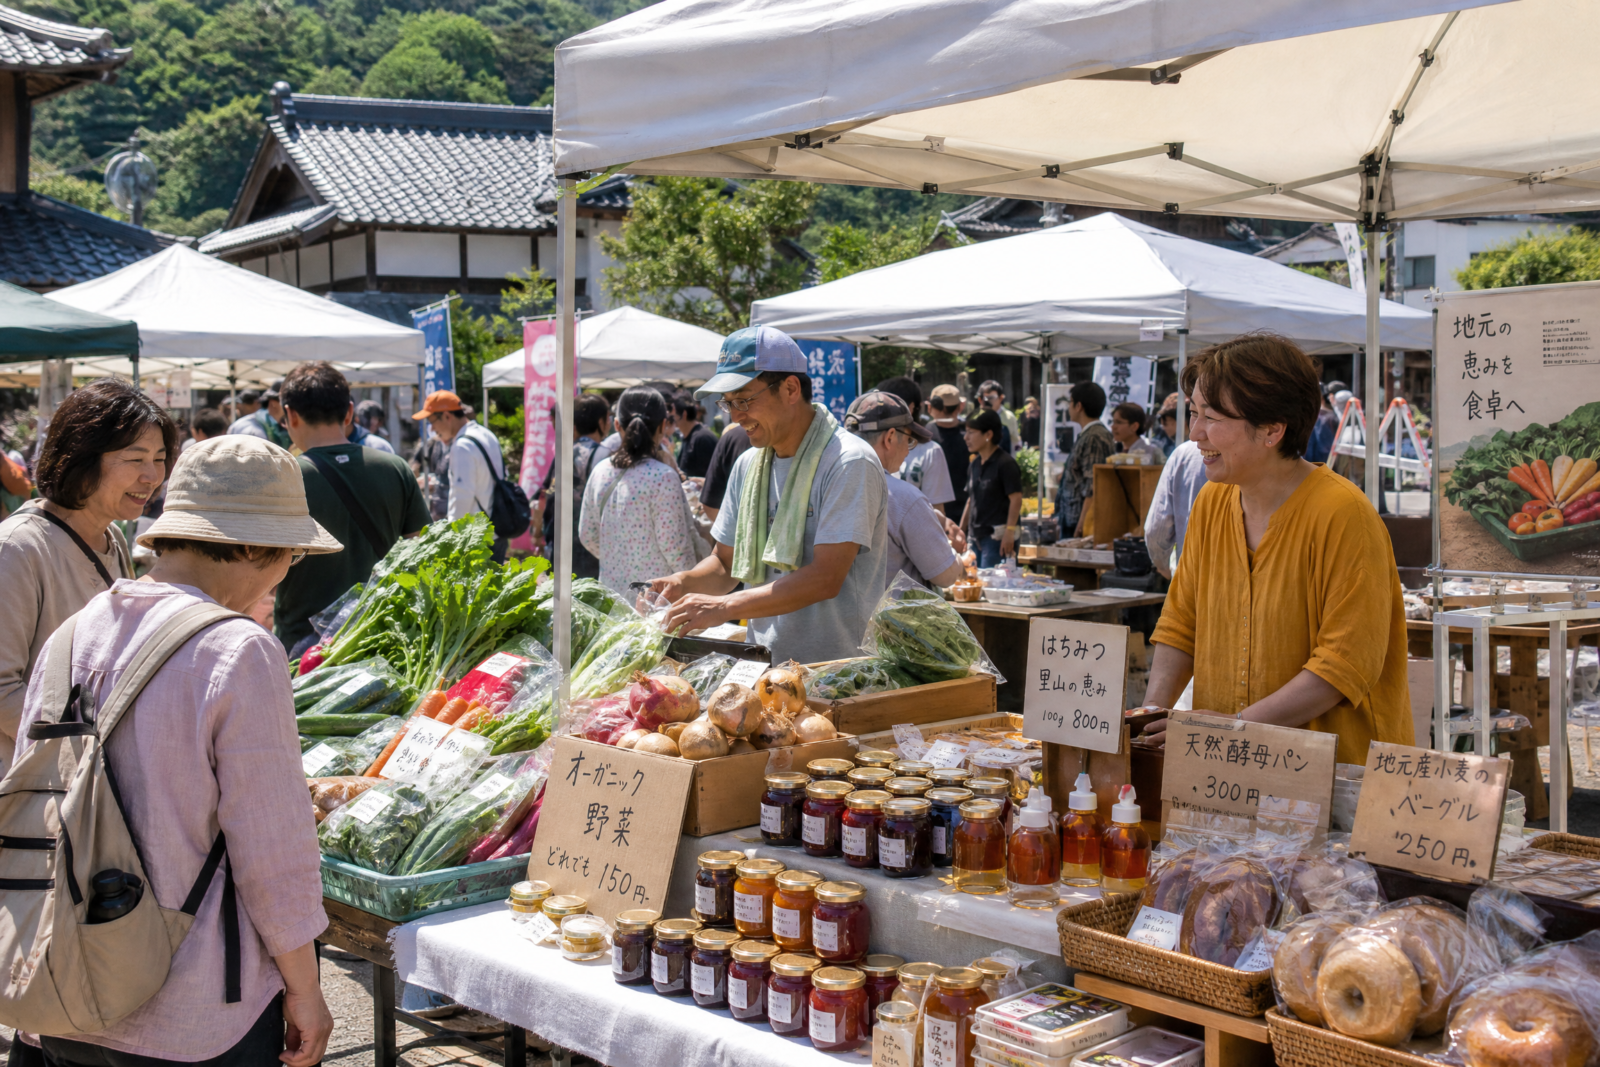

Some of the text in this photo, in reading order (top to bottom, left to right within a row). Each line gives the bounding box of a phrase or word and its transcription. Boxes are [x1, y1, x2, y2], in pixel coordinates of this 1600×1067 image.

[1454, 312, 1512, 339] 地元の
[1462, 350, 1513, 380] 恵みを
[1463, 389, 1525, 420] 食卓へ
[1041, 634, 1106, 661] はちみつ
[1039, 668, 1107, 697] 里山の恵み
[1042, 708, 1110, 735] 100g 800円
[1185, 732, 1309, 772] 天然酵母パン
[566, 750, 645, 797] オーガニック
[1373, 752, 1489, 784] 地元産小麦の
[1397, 793, 1480, 822] ベーグル
[583, 802, 634, 847] 野菜
[547, 845, 590, 877] どれでも
